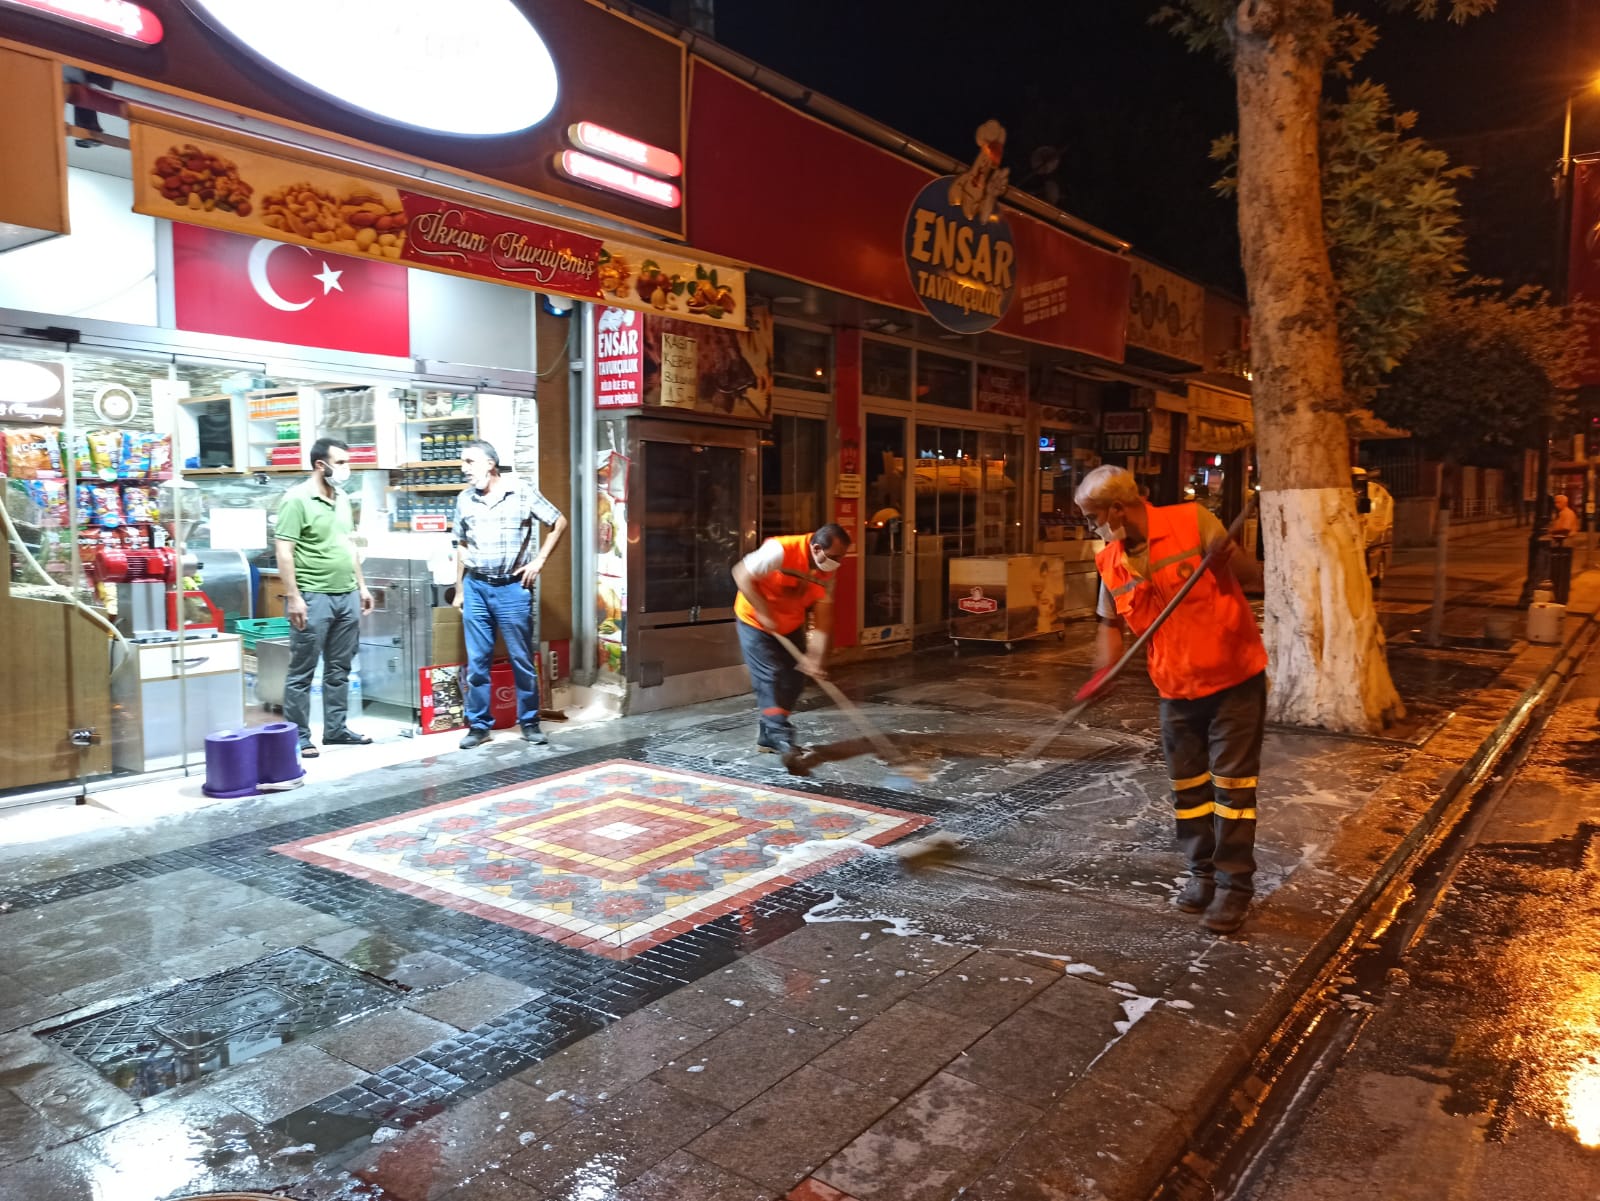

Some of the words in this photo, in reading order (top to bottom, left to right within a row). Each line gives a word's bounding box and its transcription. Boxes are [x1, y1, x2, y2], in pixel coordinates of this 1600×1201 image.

[911, 208, 1014, 289] ENSAR
[917, 270, 1004, 319] TAVUKÇULUK
[598, 330, 639, 358] ENSAR
[1107, 434, 1139, 449] TOTO
